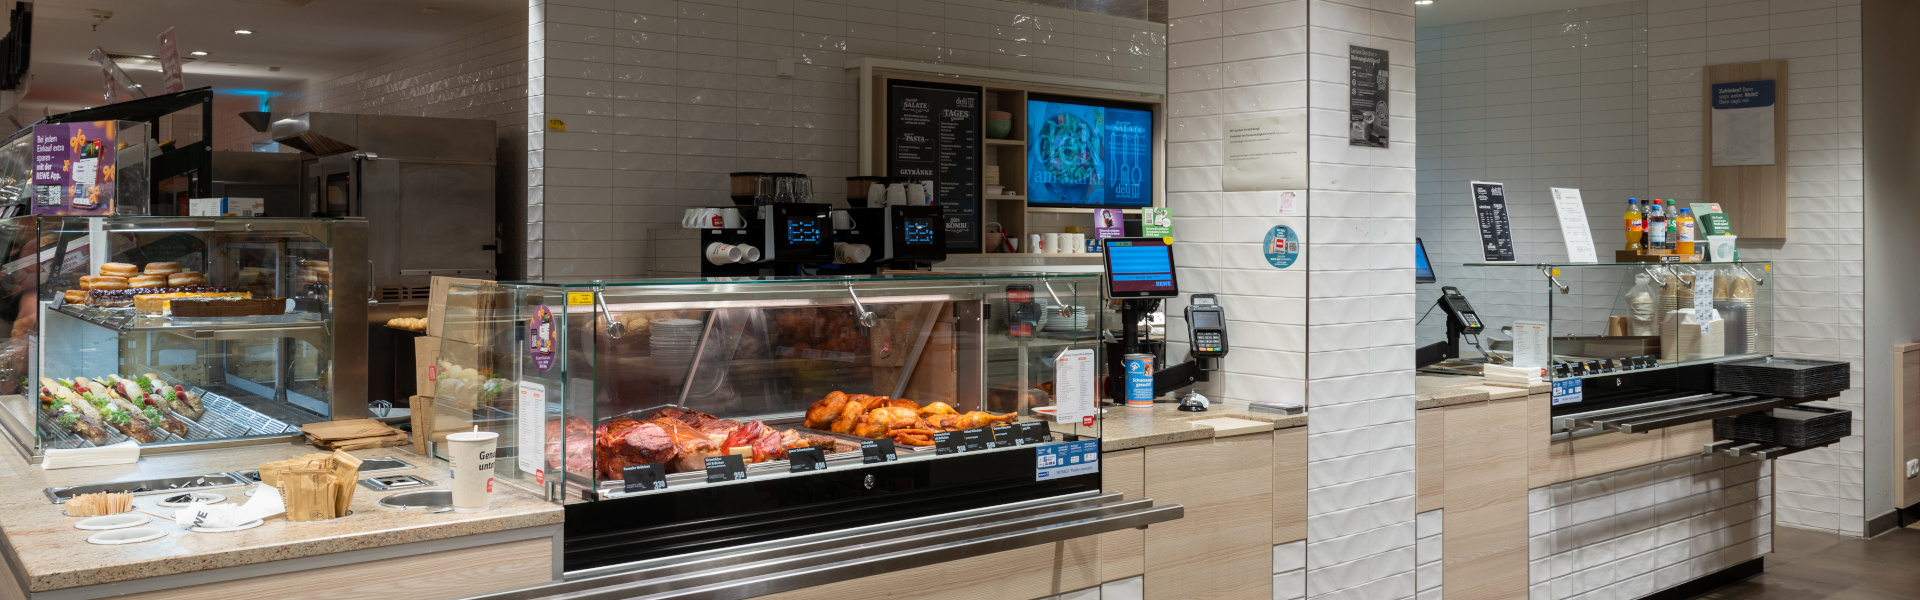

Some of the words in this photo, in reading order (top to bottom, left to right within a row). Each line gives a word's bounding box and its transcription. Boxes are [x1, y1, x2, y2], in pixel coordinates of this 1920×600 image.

[944, 109, 968, 117] TAGES
[44, 136, 57, 144] jedem
[37, 144, 52, 152] Einkauf
[50, 172, 61, 181] App.
[1116, 184, 1131, 193] deli
